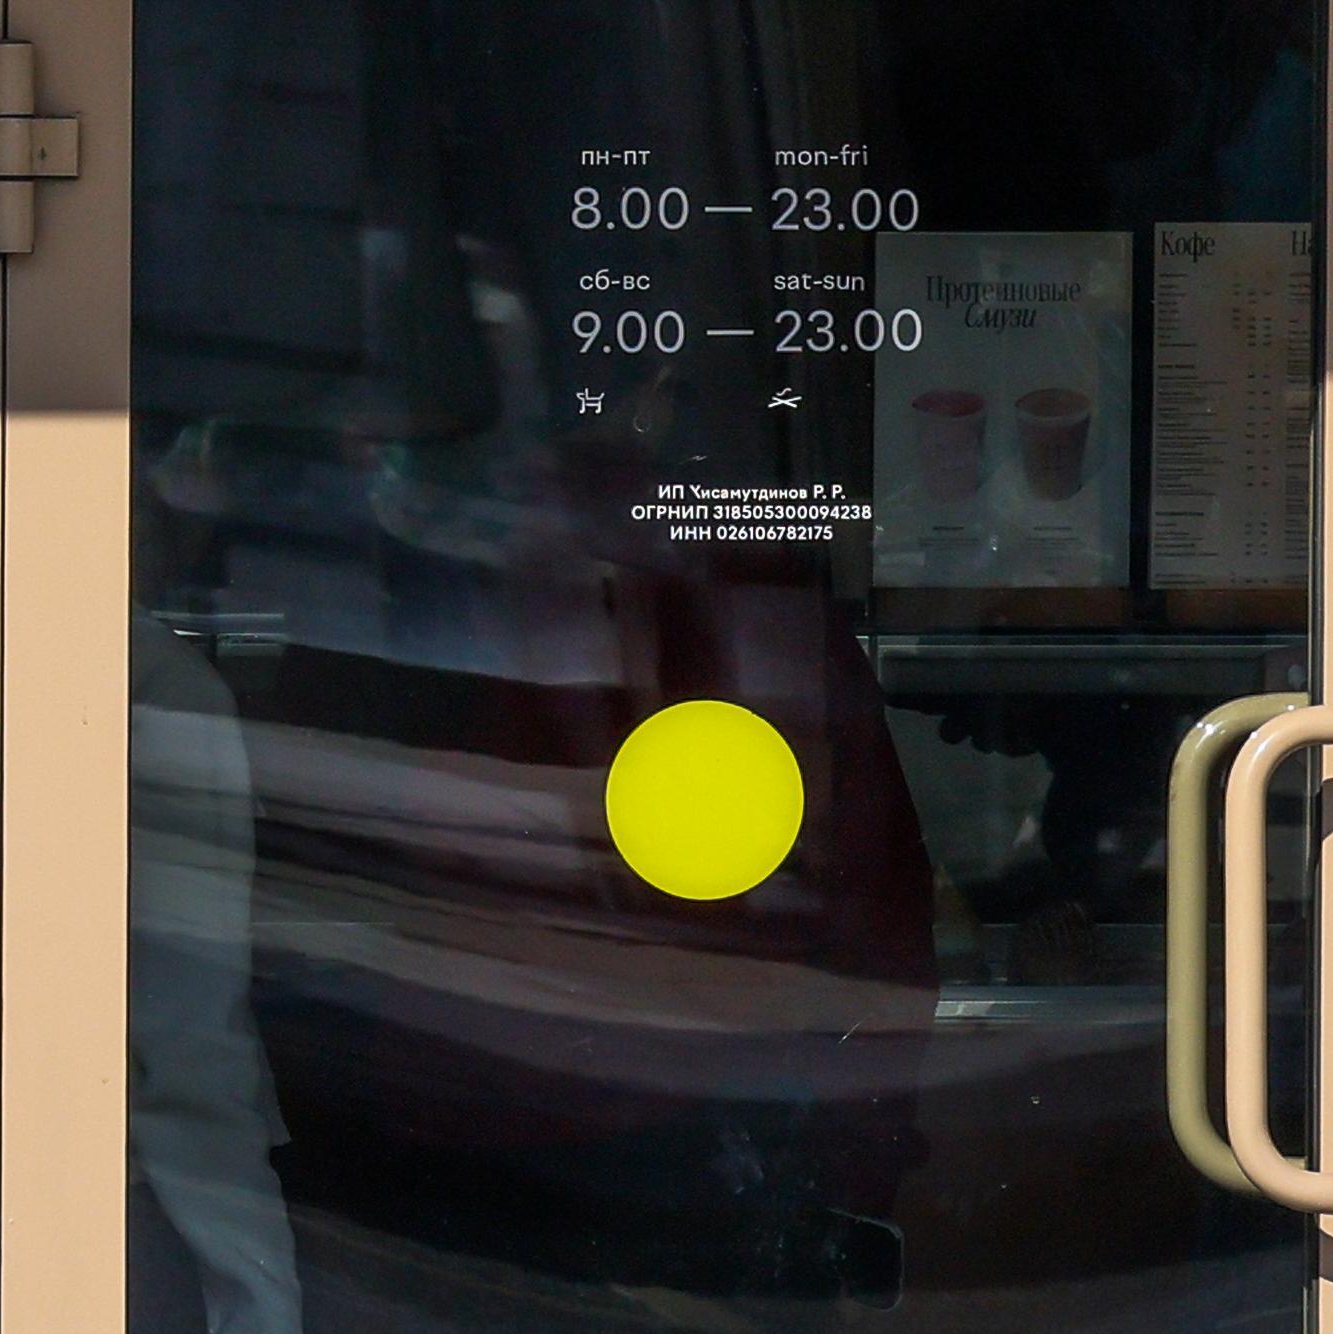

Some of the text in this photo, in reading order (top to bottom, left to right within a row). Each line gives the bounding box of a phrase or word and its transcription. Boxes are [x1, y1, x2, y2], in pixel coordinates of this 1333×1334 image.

[581, 150, 651, 166] пн-пт
[775, 144, 868, 166] mon-fri
[571, 187, 689, 231] 8.00
[771, 187, 919, 231] 23.00
[1160, 230, 1216, 263] Кофе
[579, 269, 650, 291] сб-вс
[774, 272, 865, 291] sat-sun
[926, 275, 1081, 309] Протеиновые
[964, 302, 1038, 335] Смузи
[572, 310, 684, 353] 9.00
[774, 308, 923, 352] 23.00
[658, 484, 685, 500] ИП
[813, 484, 827, 500] Р.
[831, 484, 846, 500] Р.
[630, 504, 872, 520] ОГРНИП 318505300094238
[670, 525, 834, 541] ИНН 026106782175
